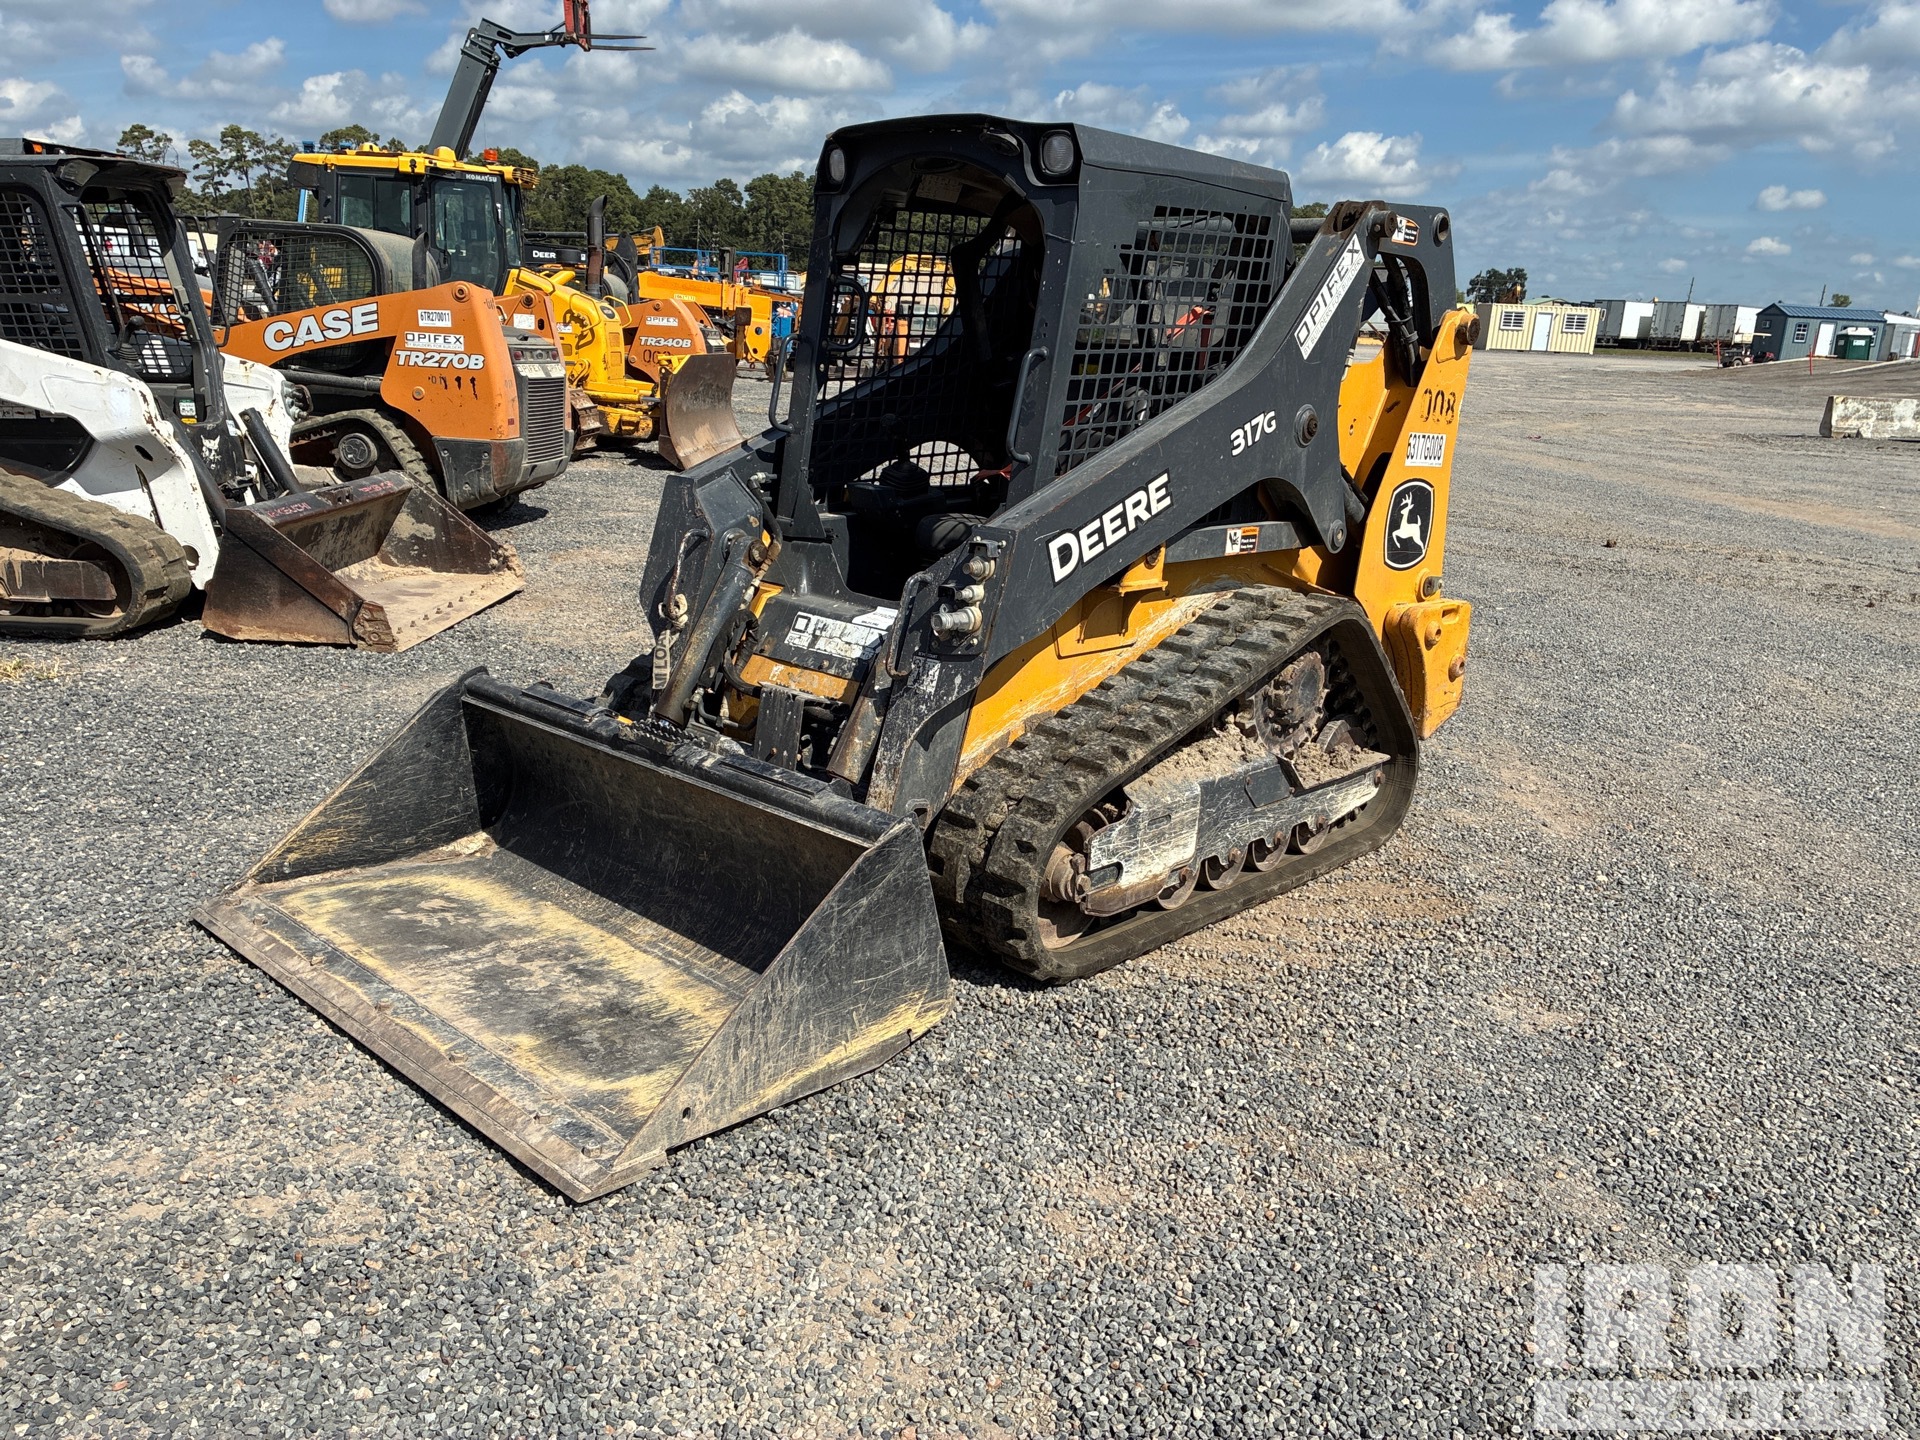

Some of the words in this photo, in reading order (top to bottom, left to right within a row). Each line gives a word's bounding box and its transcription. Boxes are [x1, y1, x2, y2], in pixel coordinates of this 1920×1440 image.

[466, 173, 497, 182] KOMATSU
[533, 250, 556, 259] DEER
[1297, 240, 1360, 348] OPIFEX
[420, 311, 450, 322] 6TR270011
[263, 301, 379, 351] CASE
[405, 333, 463, 345] OPIFEX
[640, 336, 692, 348] TR340B
[395, 350, 485, 371] TR270B
[643, 349, 671, 364] 00
[1230, 410, 1277, 457] 317G
[1406, 433, 1444, 461] 6317G008
[1048, 472, 1172, 583] DEERE
